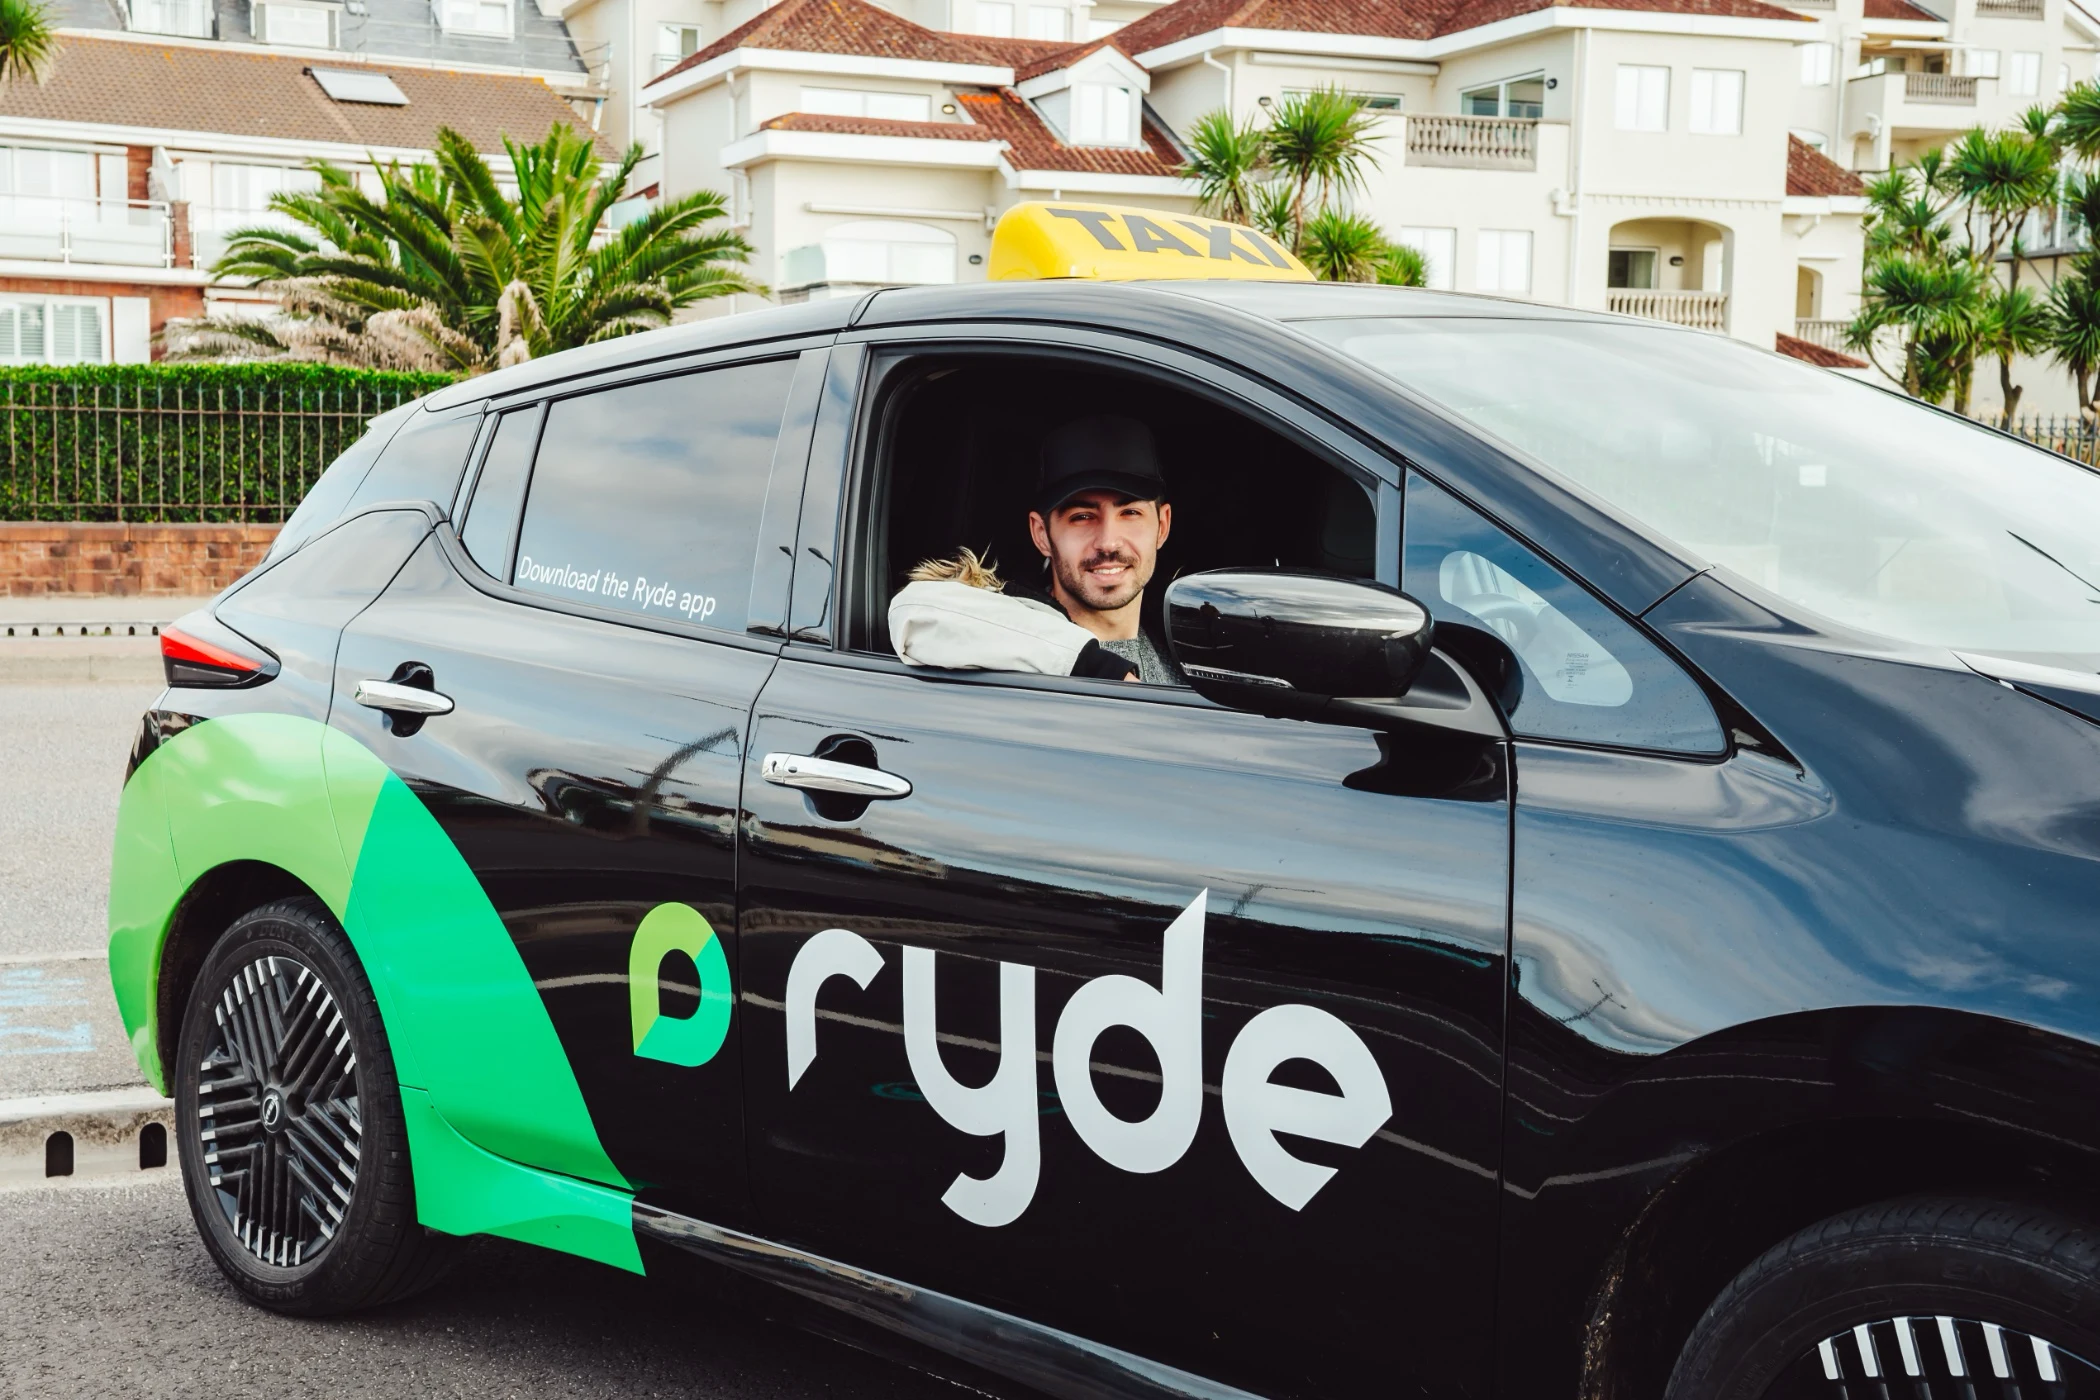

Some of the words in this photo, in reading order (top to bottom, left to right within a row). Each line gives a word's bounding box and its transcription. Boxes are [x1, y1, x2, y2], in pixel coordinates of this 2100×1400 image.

[1045, 208, 1293, 269] TAXI
[518, 556, 600, 592] Download
[601, 572, 629, 598] the
[632, 577, 676, 609] Ryde
[680, 592, 716, 620] app
[786, 887, 1393, 1227] ryde
